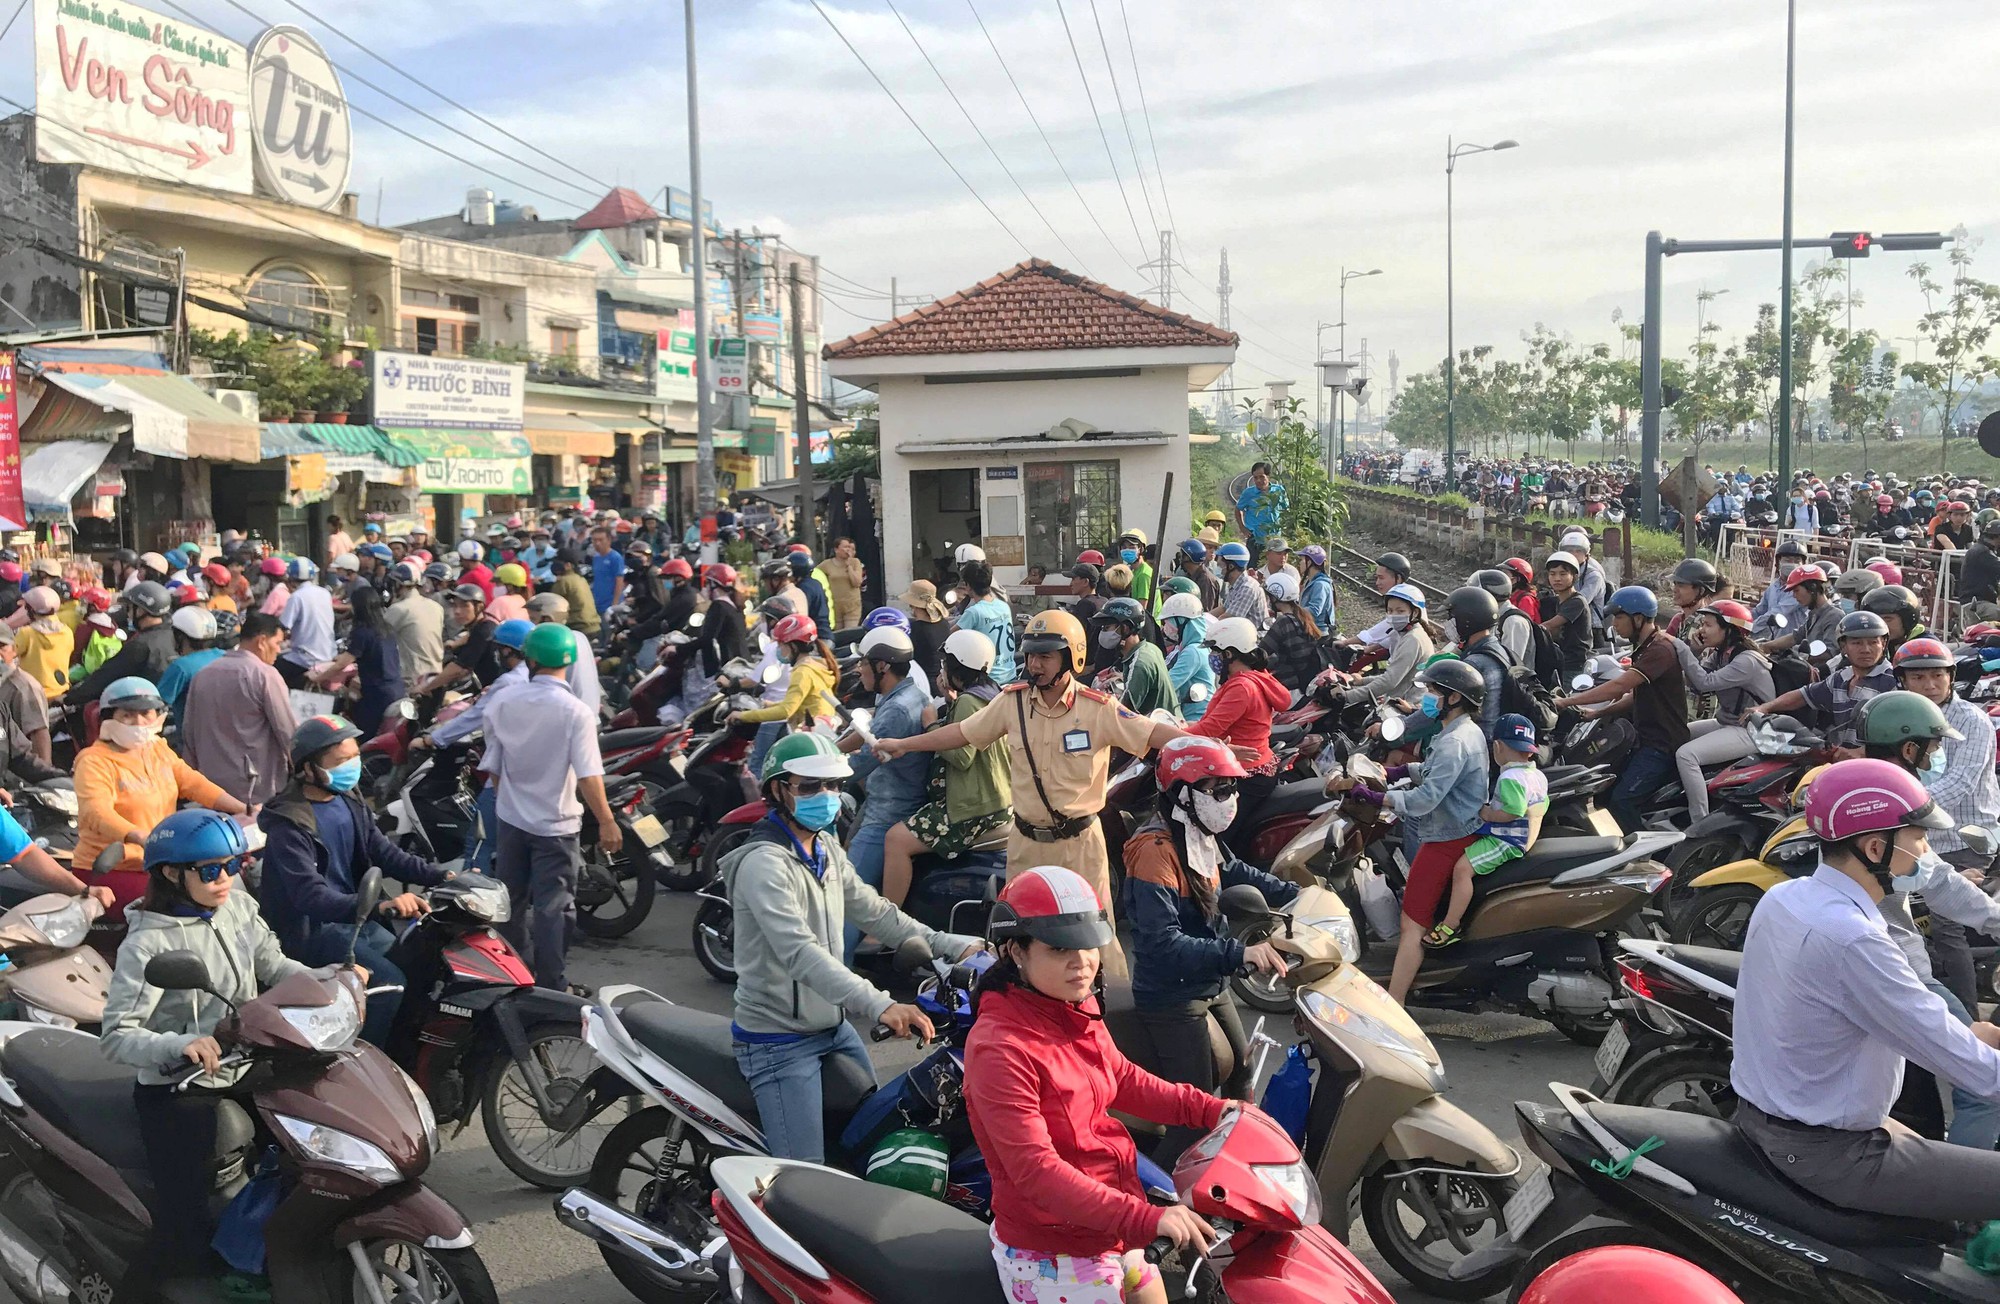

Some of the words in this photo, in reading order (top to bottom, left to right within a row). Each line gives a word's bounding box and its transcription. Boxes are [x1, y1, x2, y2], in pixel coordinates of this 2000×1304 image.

[152, 23, 161, 45] &
[163, 25, 184, 53] Câu
[56, 24, 134, 104] Ven
[142, 54, 235, 156] Sông
[407, 359, 430, 370] NHÀ
[433, 360, 467, 374] THUỐC
[470, 364, 484, 375] TƯ
[485, 367, 511, 377] NHÂN
[406, 373, 468, 394] PHƯỚC
[471, 377, 512, 398] BÌNH
[718, 376, 742, 387] 69
[988, 622, 1015, 656] 78
[1846, 806, 1871, 816] Hoàng
[439, 1002, 473, 1018] YAMAHA
[311, 1188, 351, 1201] HONDA
[1718, 1214, 1829, 1263] NOUVO
